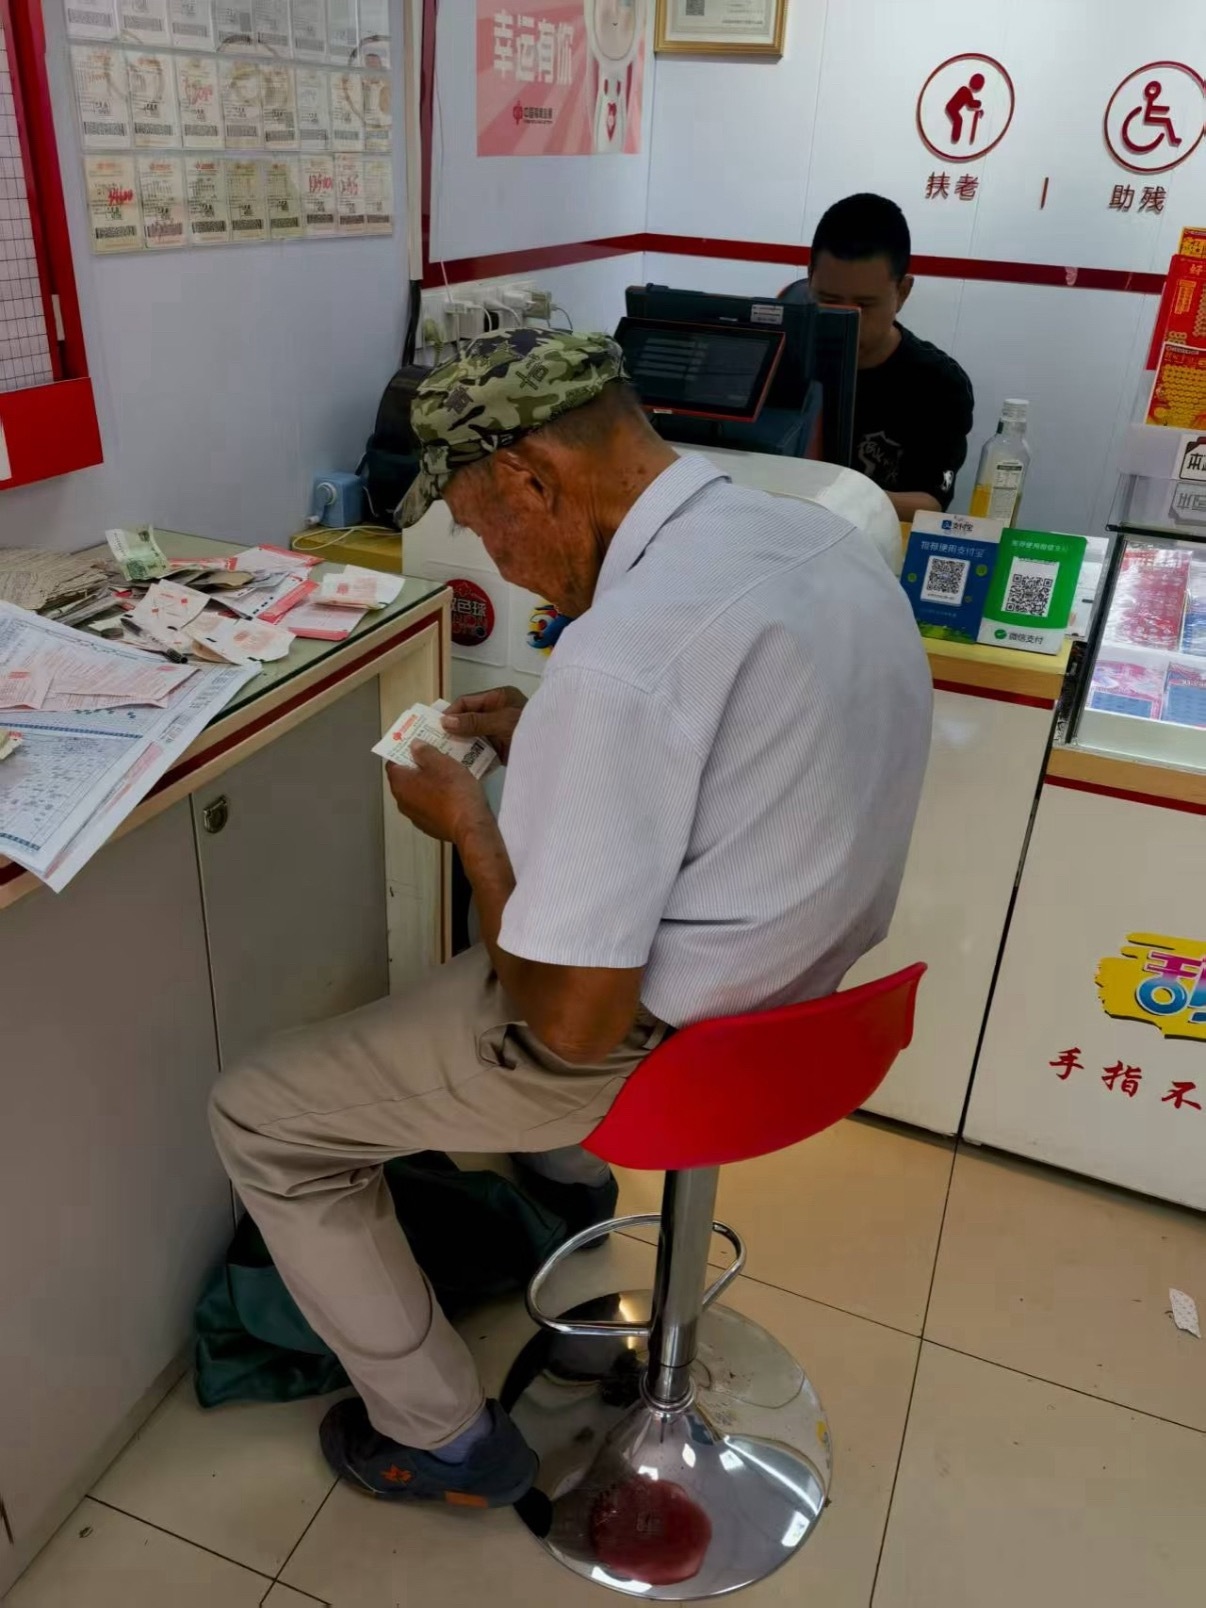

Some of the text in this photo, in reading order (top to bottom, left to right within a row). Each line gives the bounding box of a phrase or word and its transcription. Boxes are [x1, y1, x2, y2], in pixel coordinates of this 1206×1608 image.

[925, 171, 1167, 214] 扶老 助残
[1008, 631, 1044, 645] 微信支付
[1048, 1046, 1203, 1111] 手指不
